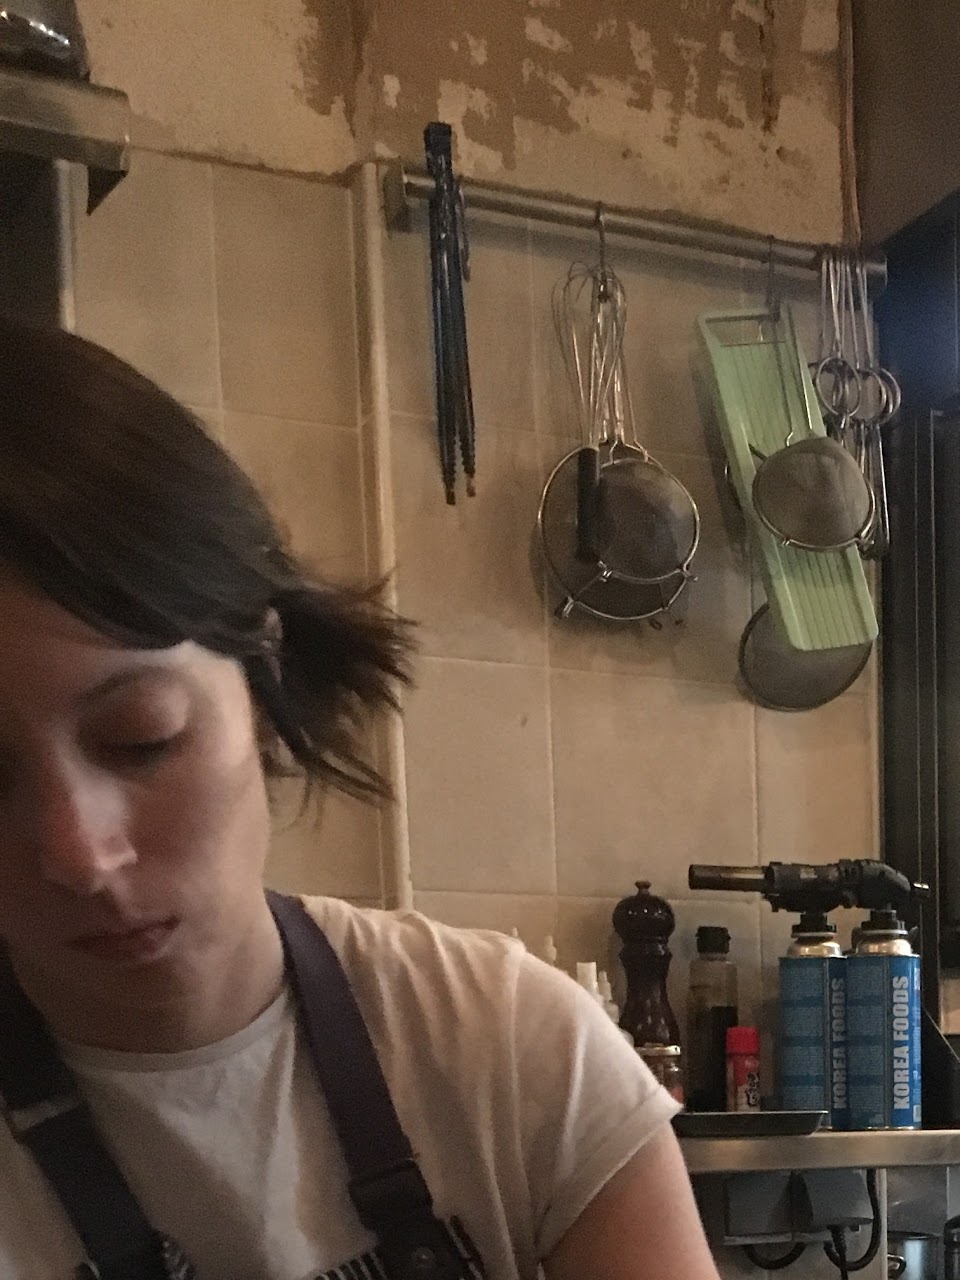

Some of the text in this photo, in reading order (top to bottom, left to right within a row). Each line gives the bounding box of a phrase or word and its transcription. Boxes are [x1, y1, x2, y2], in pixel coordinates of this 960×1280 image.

[831, 977, 847, 1109] KOREA FOODS
[892, 976, 910, 1110] KOREA FOODS
